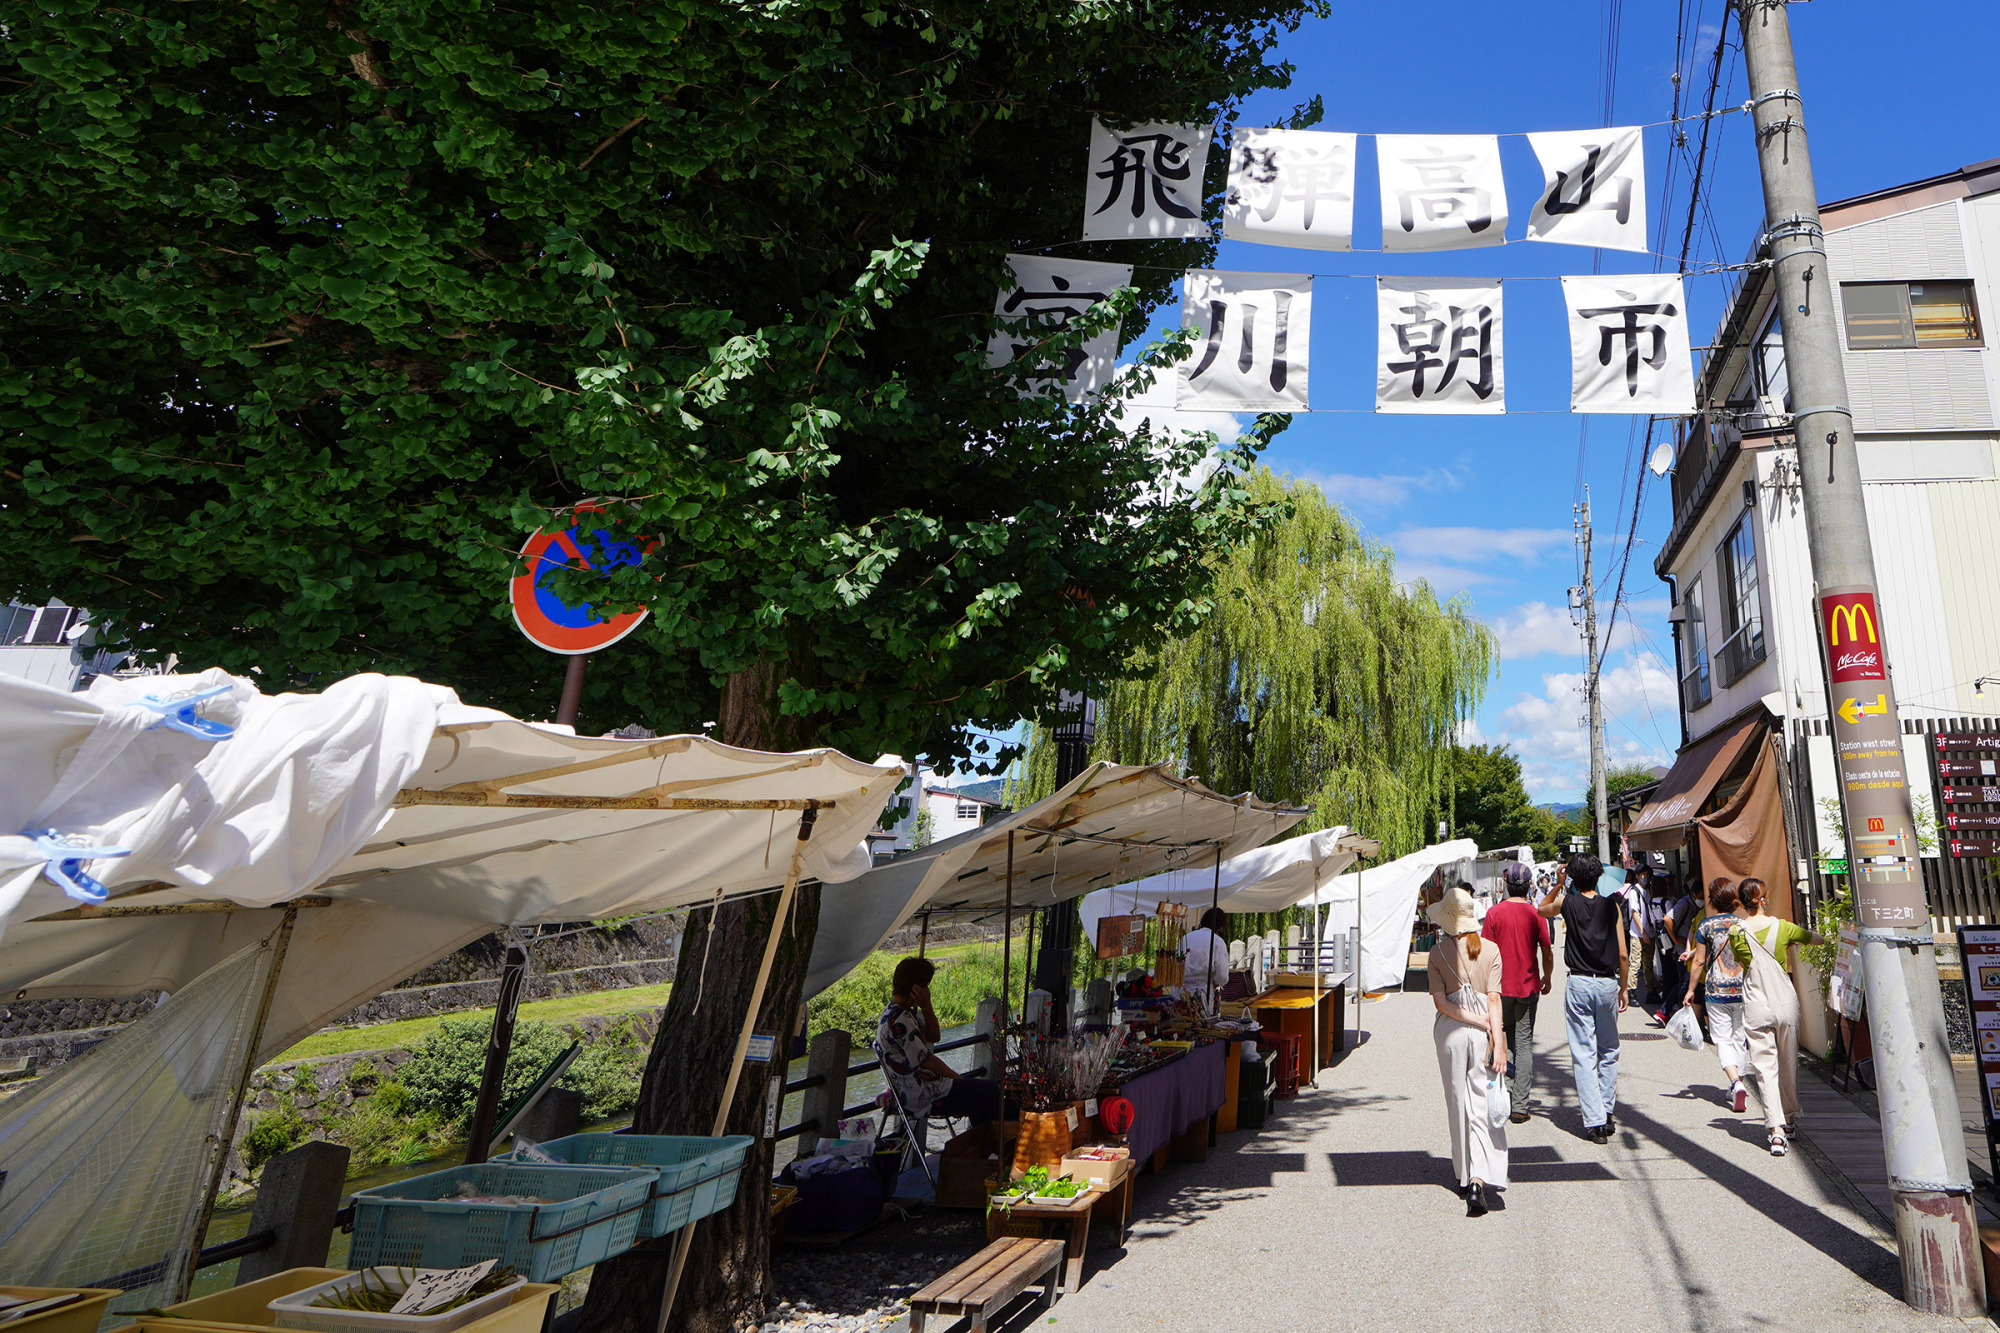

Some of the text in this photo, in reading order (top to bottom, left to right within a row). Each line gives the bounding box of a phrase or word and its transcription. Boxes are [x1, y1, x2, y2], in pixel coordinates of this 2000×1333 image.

[1840, 739, 1897, 751] Station west street
[1936, 737, 1947, 747] 3F
[1858, 752, 1873, 760] away
[1874, 749, 1888, 758] from
[1939, 763, 1951, 773] 3F
[1871, 770, 1878, 779] de
[1847, 782, 1867, 791] 900m
[1868, 780, 1890, 790] desde
[1943, 789, 1955, 800] 2F
[1947, 816, 1958, 826] 1F
[1950, 843, 1962, 853] 1F
[1871, 907, 1914, 920] 下三之町
